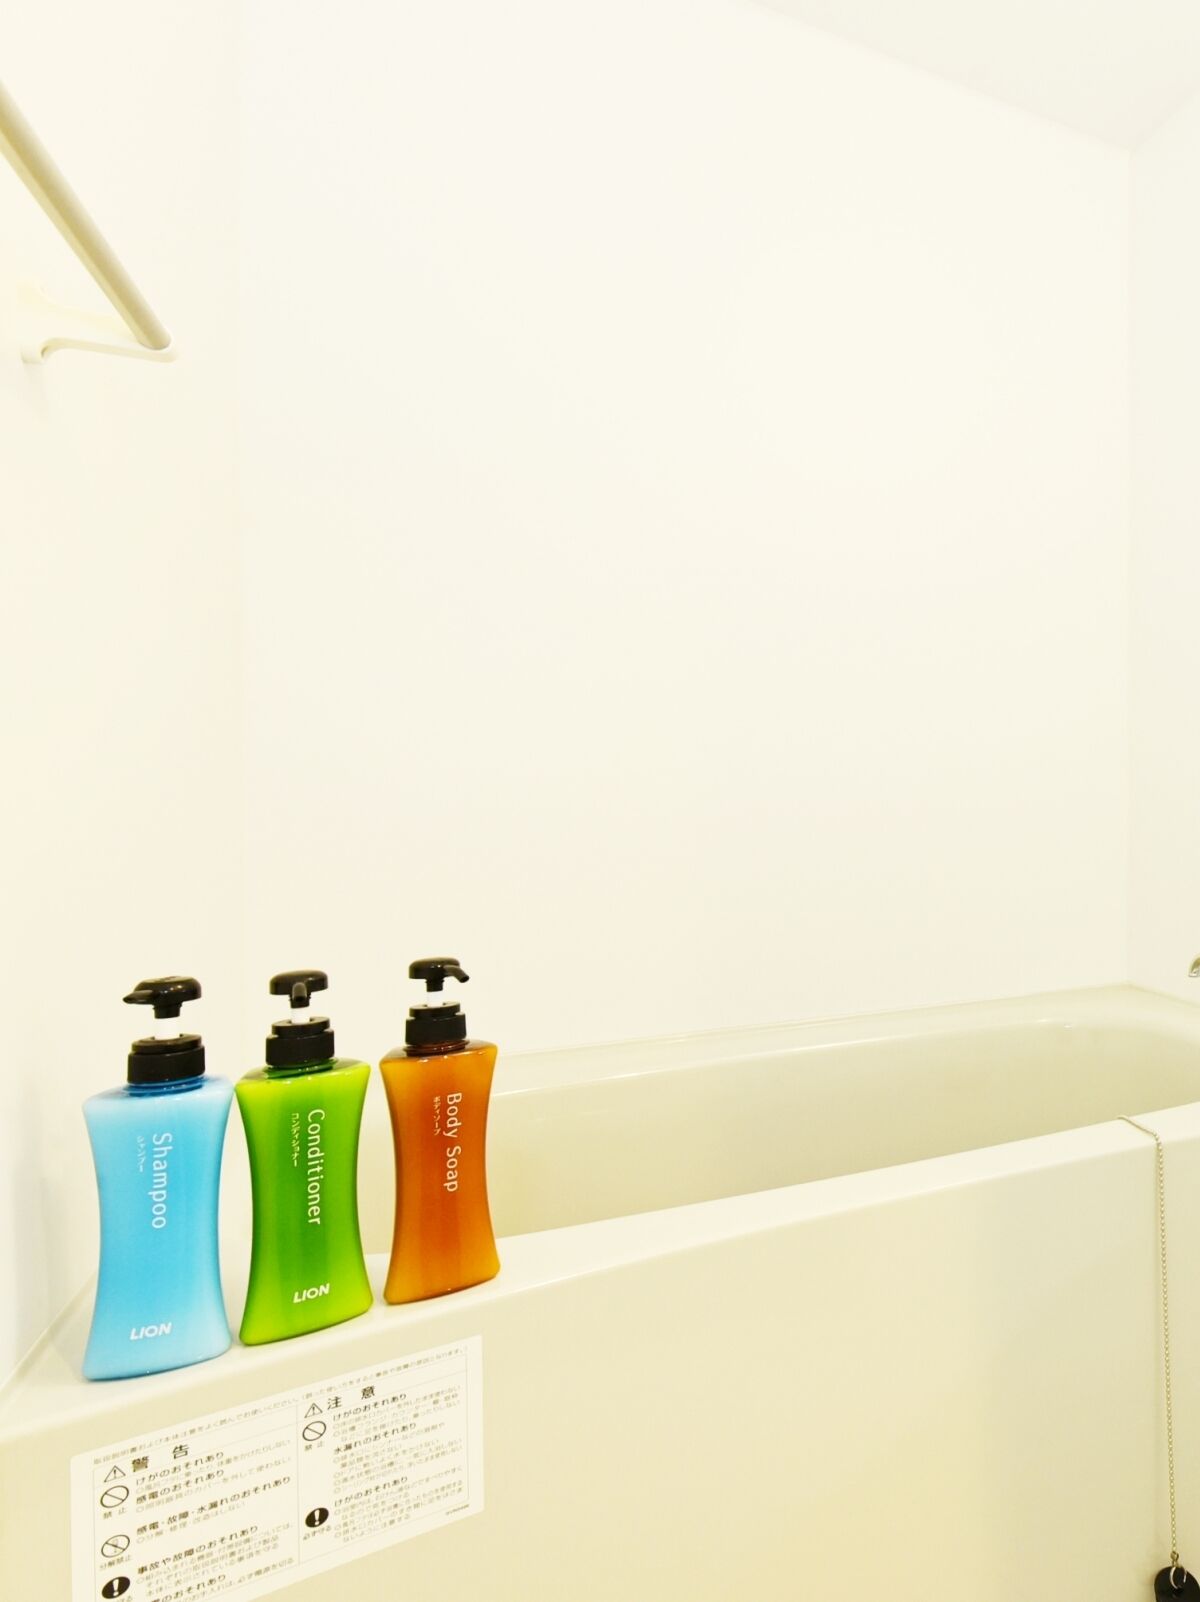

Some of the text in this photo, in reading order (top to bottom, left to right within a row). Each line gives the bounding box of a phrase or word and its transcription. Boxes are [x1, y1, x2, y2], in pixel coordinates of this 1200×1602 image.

[443, 1092, 463, 1193] Body Soap
[147, 1132, 173, 1229] Shampoo
[307, 1108, 326, 1225] Conditioner
[292, 1283, 331, 1304] LION
[129, 1322, 172, 1341] LION
[333, 1393, 407, 1422] けがのおそれあり
[135, 1451, 224, 1486] けがのおそれあり
[135, 1469, 224, 1505] 感電のおそれあり
[334, 1475, 408, 1507] けがのおそれあり
